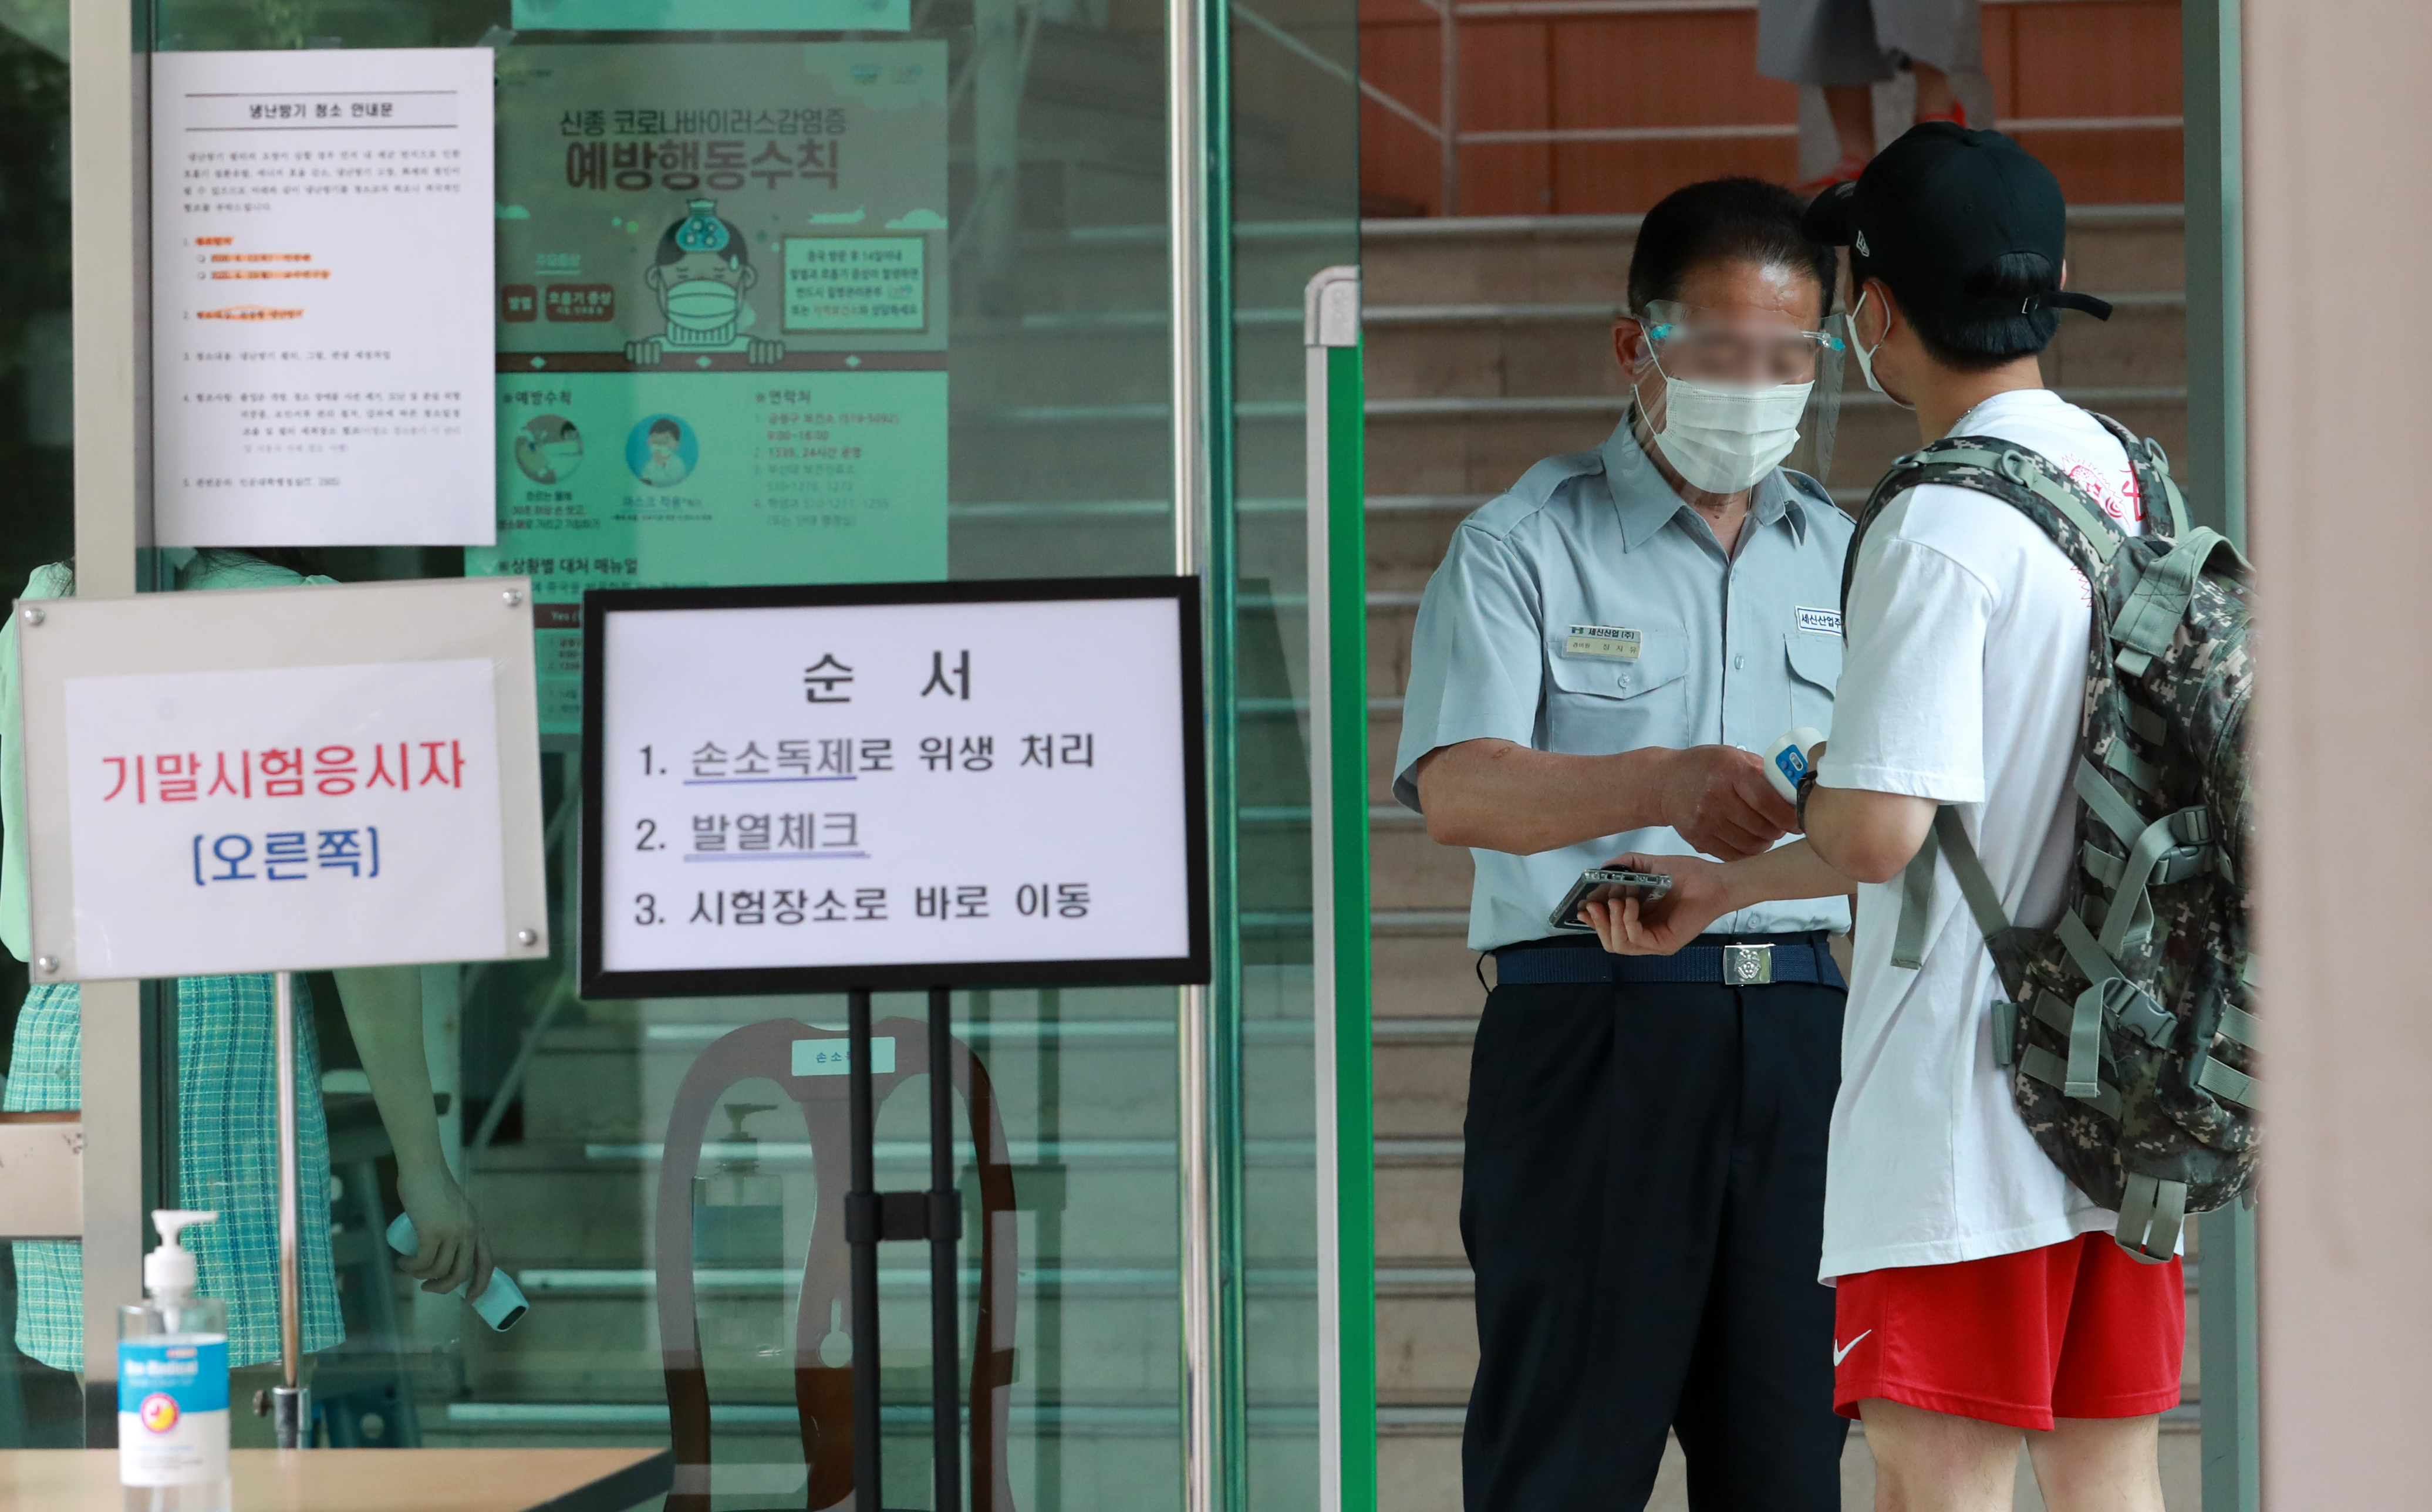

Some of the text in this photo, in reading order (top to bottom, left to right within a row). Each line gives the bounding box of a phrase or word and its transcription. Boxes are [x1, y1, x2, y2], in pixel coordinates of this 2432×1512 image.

[250, 103, 393, 119] 냉난방기 청소 안내문
[560, 108, 846, 136] 신종 코로나바이러스감염증
[566, 140, 839, 191] 예방행동수칙
[559, 558, 589, 575] 대처
[593, 557, 639, 575] 매뉴얼
[1588, 629, 1619, 637] 세신산업
[102, 739, 466, 804] 기말시험응시자
[640, 733, 1095, 778] 1. 손소독제로 위생 처리
[636, 811, 860, 853] 2. 발열체크
[635, 881, 1091, 926] 3. 시험장소로 바로 이동
